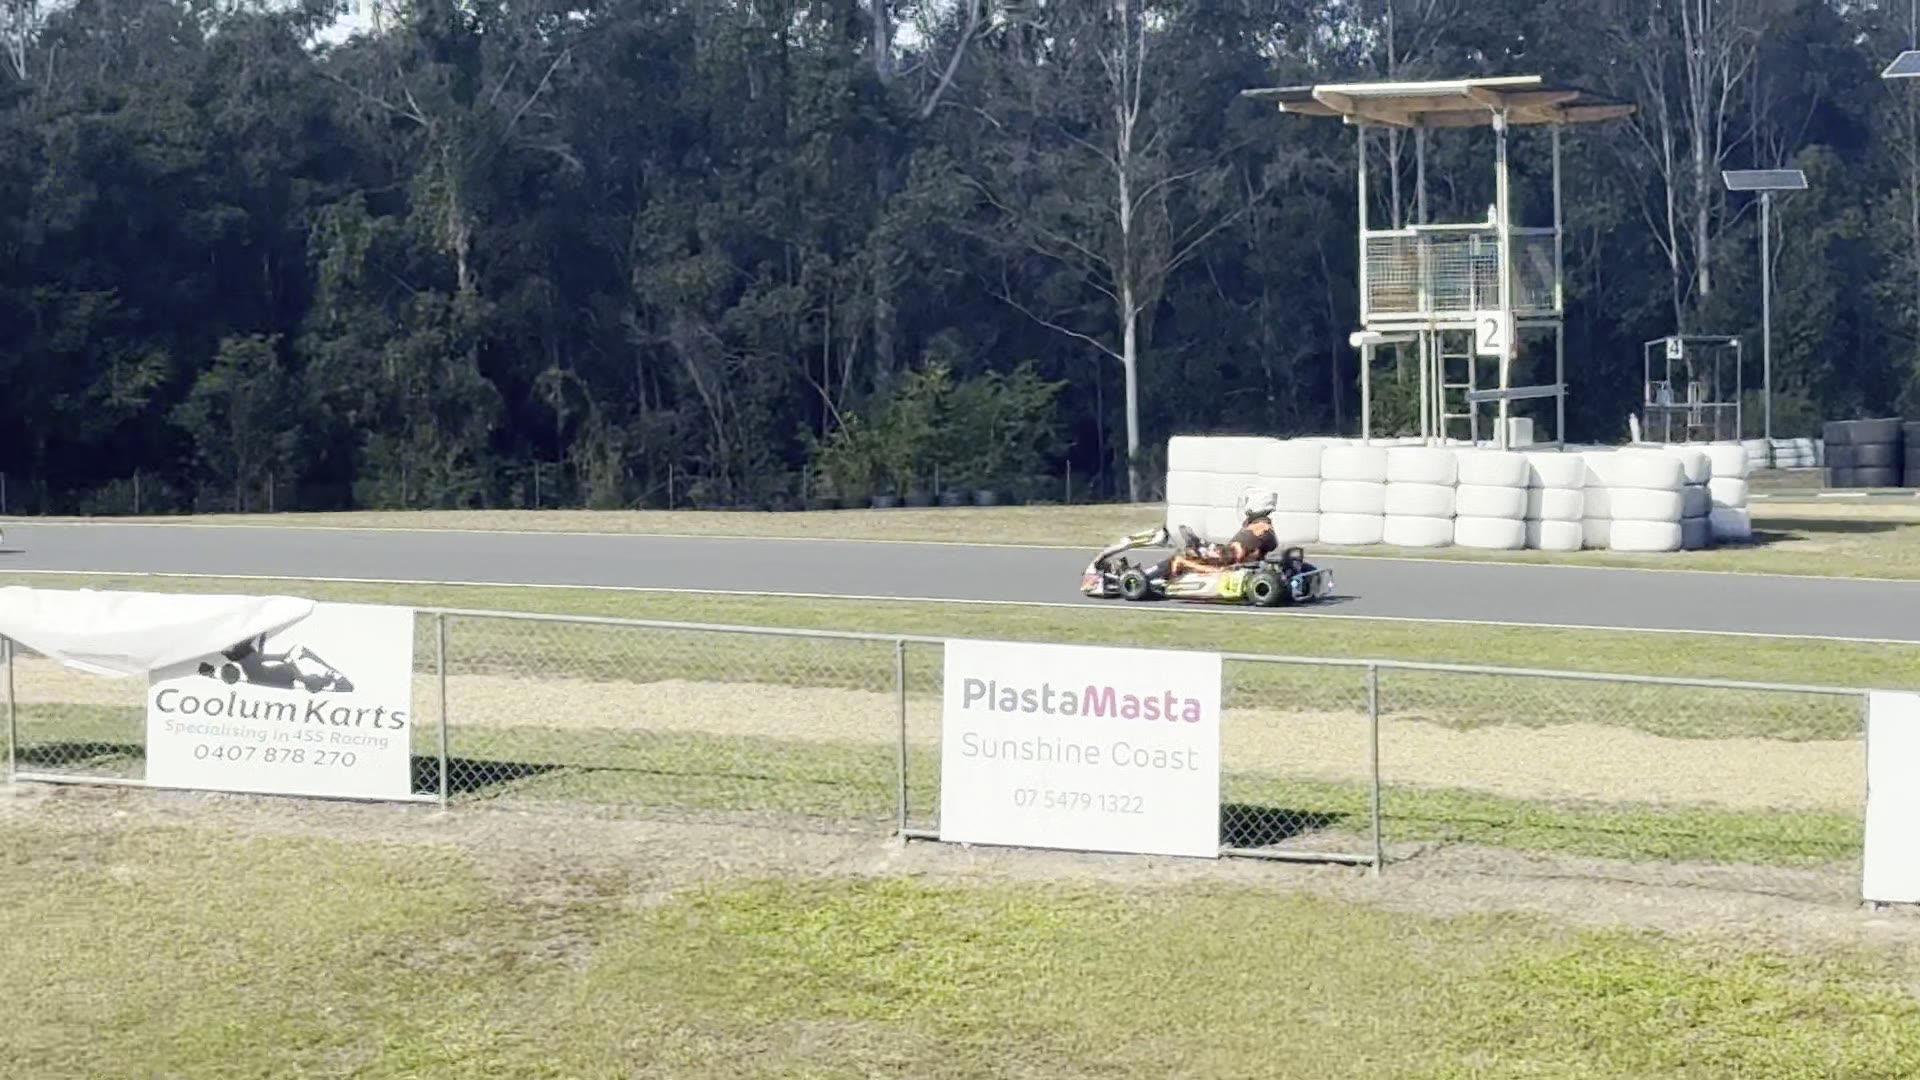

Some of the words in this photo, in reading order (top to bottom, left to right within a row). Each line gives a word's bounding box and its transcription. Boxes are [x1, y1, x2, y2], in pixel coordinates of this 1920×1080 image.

[1483, 318, 1500, 348] 2
[1670, 339, 1680, 355] 4
[962, 677, 1201, 723] PlastaMasta
[164, 719, 268, 743] Specialising
[330, 731, 389, 750] Racing
[194, 744, 255, 762] 0407
[264, 747, 305, 764] 878
[314, 750, 357, 767] 270
[962, 732, 1100, 765] Sunshine
[1112, 741, 1199, 771] Coast
[1014, 788, 1038, 807] 07
[1044, 790, 1092, 811] 5479
[1098, 794, 1144, 814] 1322
